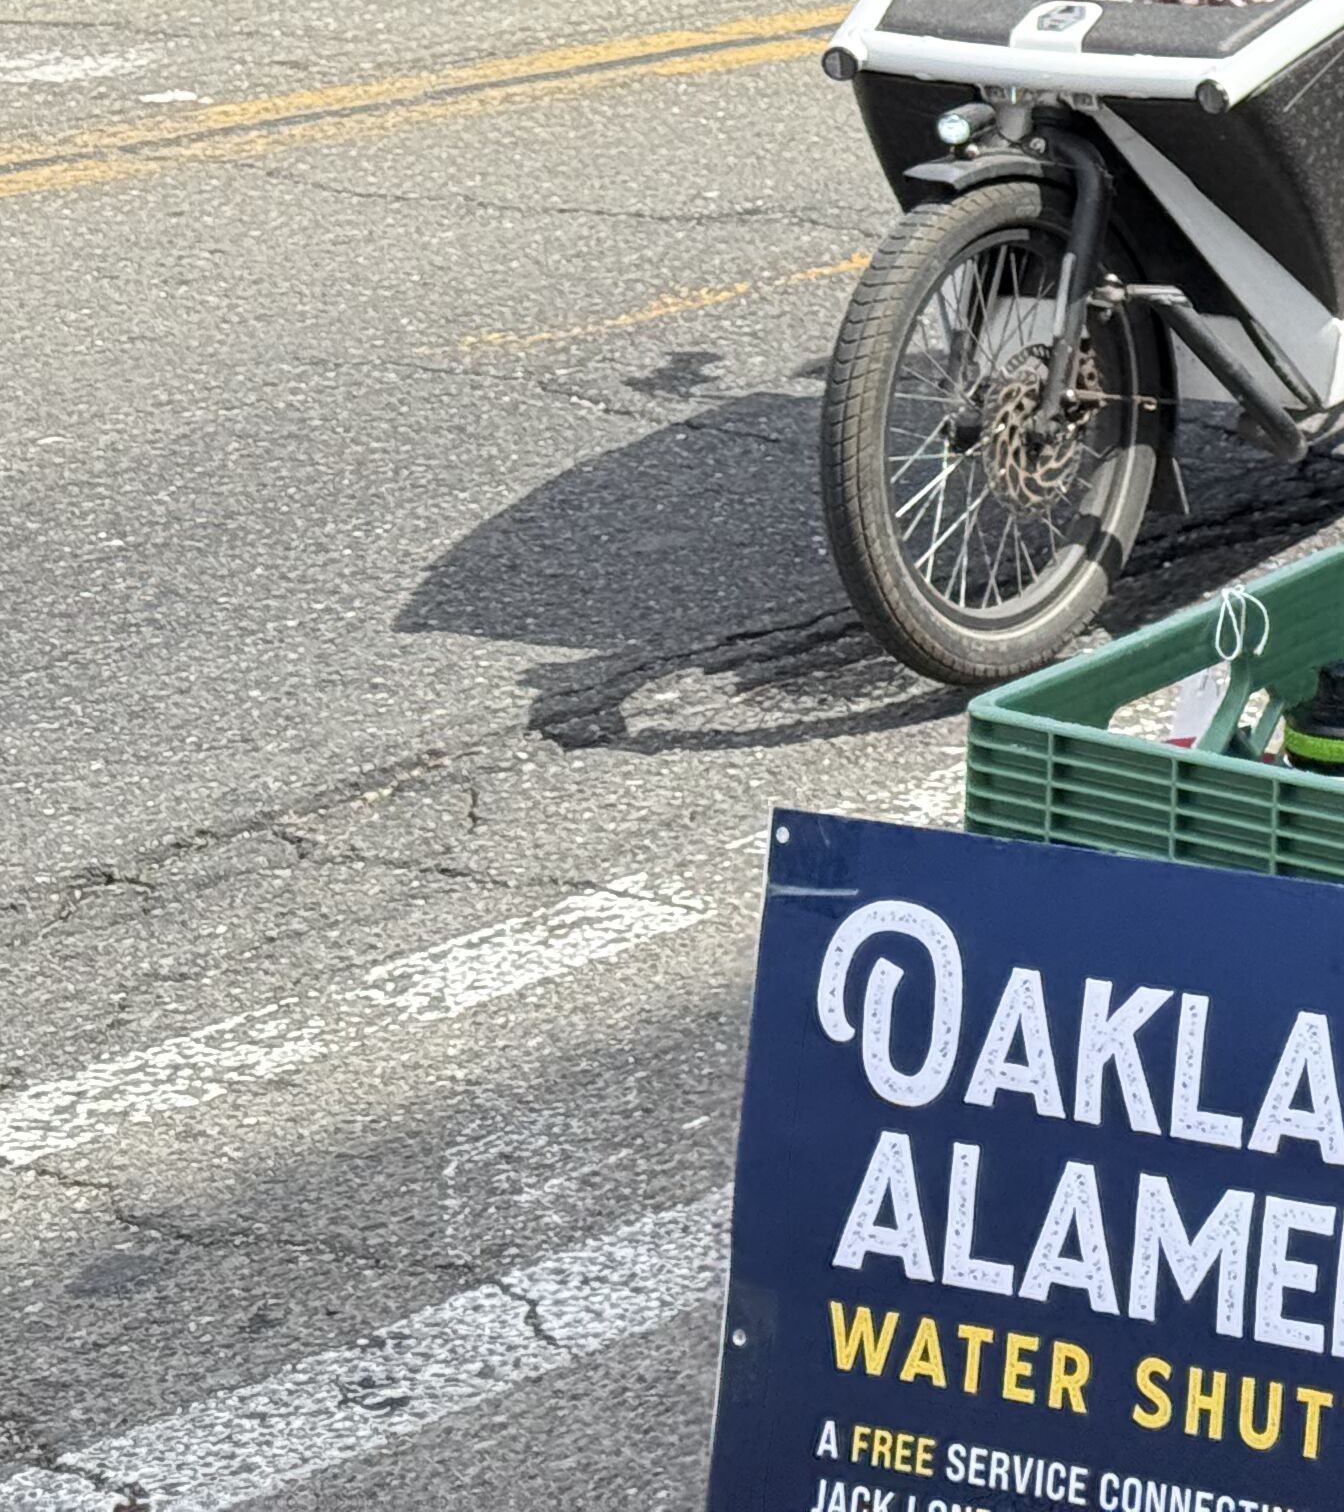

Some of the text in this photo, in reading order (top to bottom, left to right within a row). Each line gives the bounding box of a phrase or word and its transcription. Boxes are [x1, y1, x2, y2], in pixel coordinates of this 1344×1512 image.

[829, 1300, 1092, 1414] WATER
[816, 1420, 840, 1459] A
[850, 1424, 938, 1476] FREE
[946, 1443, 1089, 1506] SERVICE
